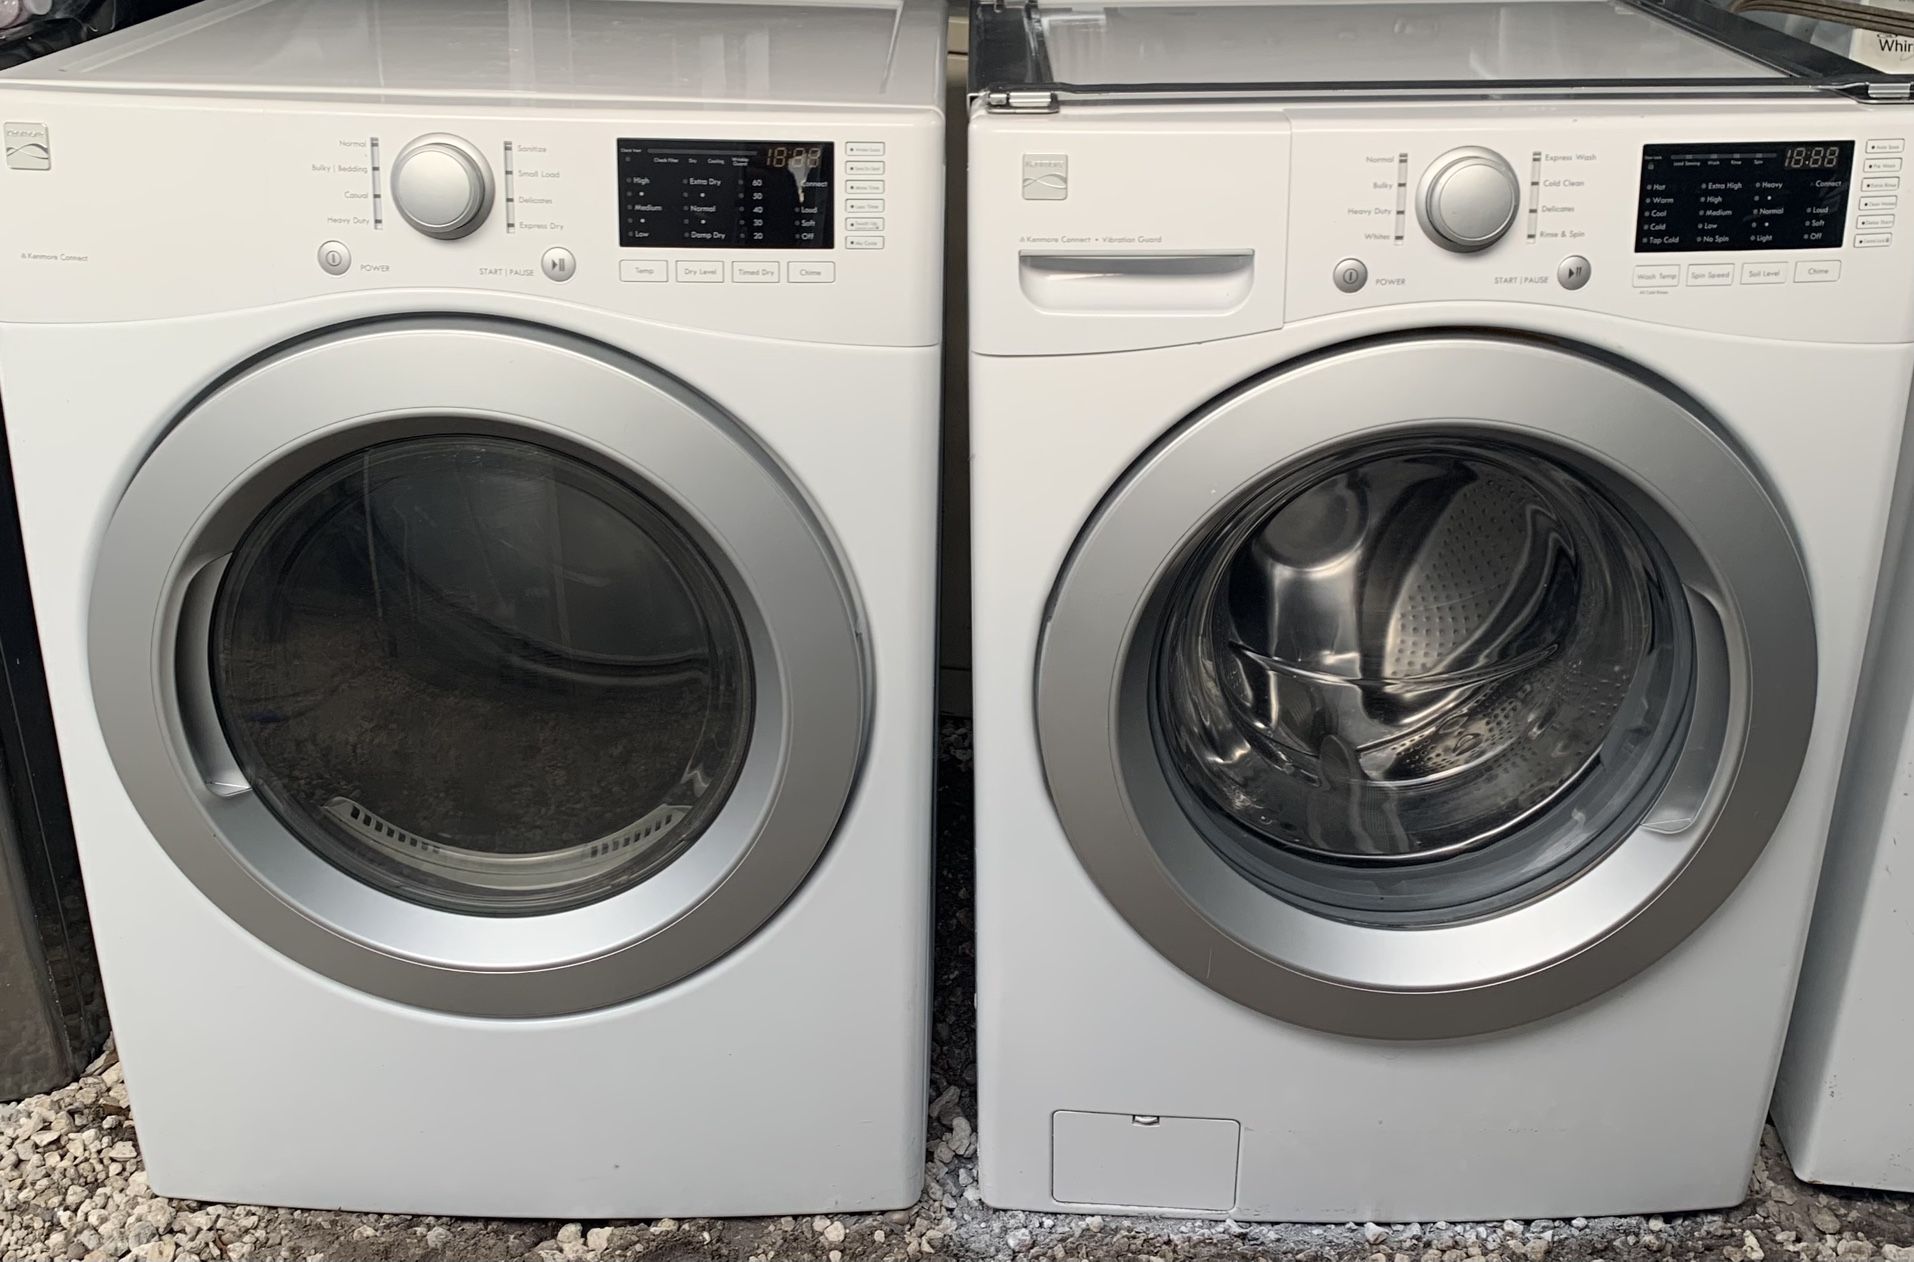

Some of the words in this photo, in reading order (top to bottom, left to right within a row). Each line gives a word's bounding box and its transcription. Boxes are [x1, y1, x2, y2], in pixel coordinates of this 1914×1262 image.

[1879, 39, 1914, 52] Whir
[518, 145, 547, 153] Sanitize
[1545, 154, 1572, 162] Express
[1785, 147, 1839, 168] 18:88
[312, 164, 331, 172] Bulky
[338, 165, 368, 174] Bedding
[518, 170, 538, 178] Small
[633, 177, 650, 185] High
[709, 178, 721, 186] Dry
[1543, 179, 1560, 187] Cold
[1373, 182, 1393, 190] Bulky
[1727, 182, 1742, 190] High
[1762, 182, 1783, 190] Heavy
[344, 191, 369, 199] Casual
[1707, 196, 1722, 204] High
[353, 217, 369, 225] Duty
[520, 222, 547, 230] Express
[550, 222, 564, 231] Dry
[713, 232, 726, 240] Dry
[1569, 230, 1585, 238] Spin
[1715, 235, 1729, 243] Spin
[1757, 235, 1772, 243] Light
[360, 264, 390, 272] POWER
[480, 268, 502, 276] START
[635, 267, 654, 275] Temp
[684, 268, 698, 276] Dry
[762, 269, 775, 277] Dry
[1660, 273, 1677, 281] Temp
[1692, 272, 1706, 280] Spin
[1708, 271, 1730, 280] Speed
[1749, 270, 1761, 278] Soil
[1763, 269, 1781, 277] Level
[1376, 278, 1406, 286] POWER
[1524, 276, 1549, 284] PAUSE
